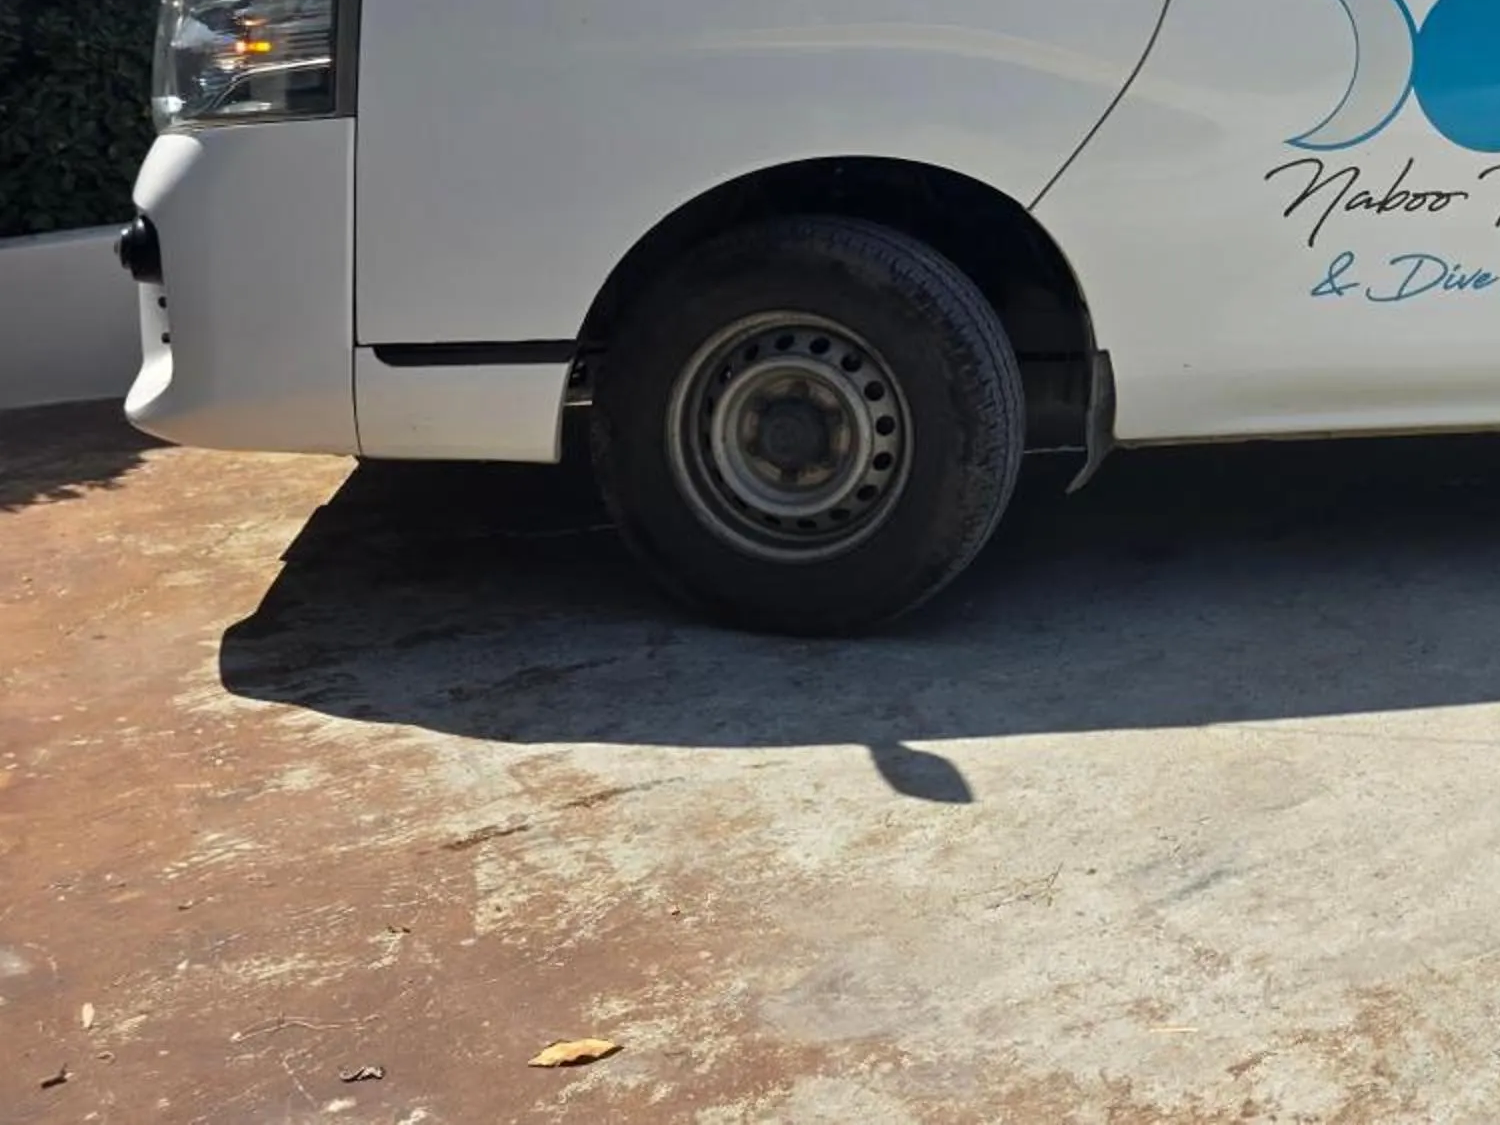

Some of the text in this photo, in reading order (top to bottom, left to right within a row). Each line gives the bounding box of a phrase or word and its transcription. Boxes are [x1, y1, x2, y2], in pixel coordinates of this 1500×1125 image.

[1264, 157, 1468, 247] Naboo
[1311, 251, 1360, 297] &
[1366, 254, 1499, 302] Dive
